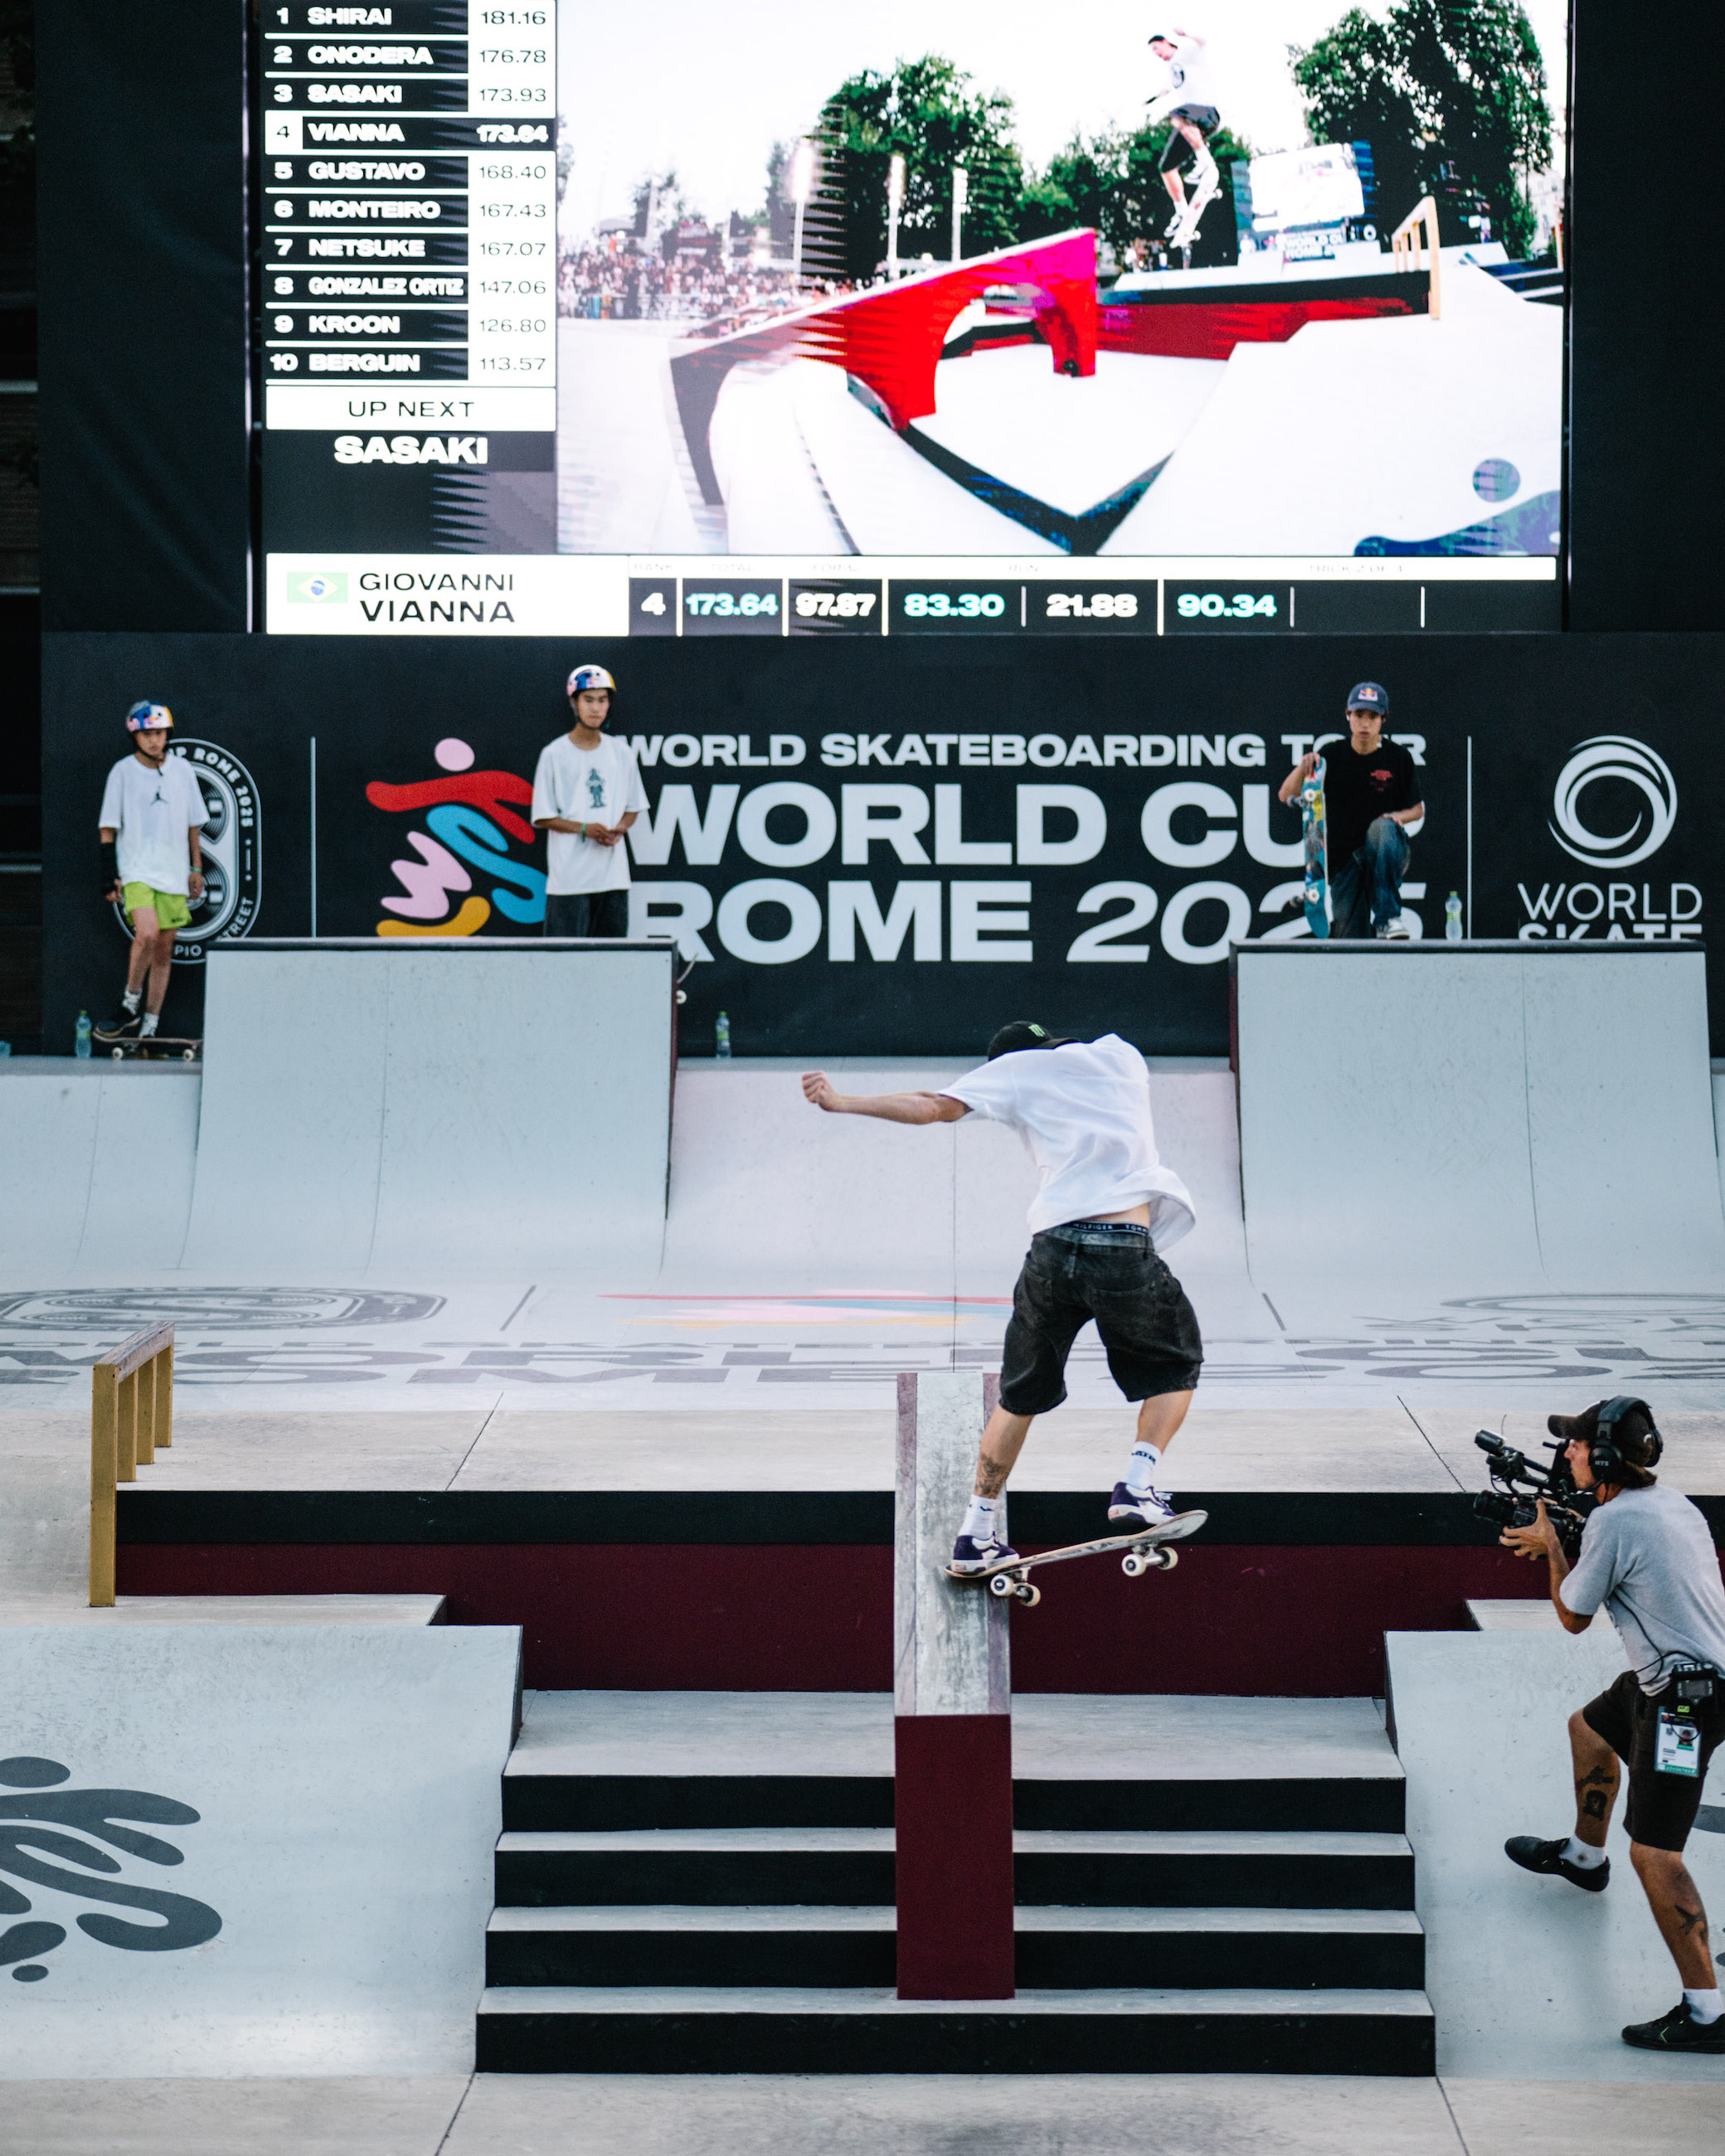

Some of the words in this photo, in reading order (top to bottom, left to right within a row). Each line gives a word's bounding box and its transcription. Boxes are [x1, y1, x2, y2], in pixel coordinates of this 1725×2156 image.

[277, 7, 289, 24] 1
[308, 7, 391, 25] SHIRAI
[481, 11, 547, 25] 181.16
[274, 46, 292, 64] 2
[308, 46, 434, 65] ONODERA
[479, 50, 547, 63] 176.78
[274, 85, 292, 103] 3
[308, 85, 401, 103] SASAKI
[479, 88, 547, 102] 173.93
[276, 126, 289, 138] 4
[308, 124, 405, 142] VIANNA
[477, 124, 548, 143] 173.64
[275, 162, 293, 179] 5
[309, 162, 425, 180] GUSTAVO
[479, 166, 547, 179] 168.40
[275, 200, 293, 218] 6
[309, 200, 440, 219] MONTEIRO
[479, 204, 547, 217] 167.43
[275, 239, 293, 255] 7
[309, 239, 425, 257] NETSUKE
[479, 243, 547, 255] 167.07
[275, 277, 294, 294] 8
[309, 277, 407, 295] GONZALEZ
[409, 278, 464, 295] ORTIZ
[479, 281, 547, 294] 147.06
[275, 315, 294, 333] 9
[309, 315, 400, 333] KROON
[479, 318, 547, 333] 126.80
[270, 353, 298, 371] 10
[309, 353, 420, 371] BERGUIN
[479, 357, 547, 371] 113.57
[348, 401, 386, 417] UP
[398, 401, 474, 417] NEXT
[333, 435, 488, 464] SASAKI
[359, 573, 513, 591] GIOVANNI
[359, 600, 515, 623] VIANNA
[641, 593, 665, 615] 4
[685, 593, 779, 616] 173.64
[795, 593, 877, 617] 97.87
[905, 594, 1005, 617] 83.30
[1046, 594, 1139, 617] 21.88
[1177, 594, 1277, 618] 90.34
[615, 734, 807, 767] WORLD
[821, 733, 1266, 767] SKATEBOARDING
[1281, 734, 1426, 767] TR
[192, 747, 241, 784] ROME
[236, 784, 254, 828] 2025
[628, 781, 1108, 867] WORLD
[1140, 781, 1426, 868] CU
[1517, 882, 1703, 920] WORLD
[216, 896, 254, 940] TREET
[628, 878, 1033, 964] ROME
